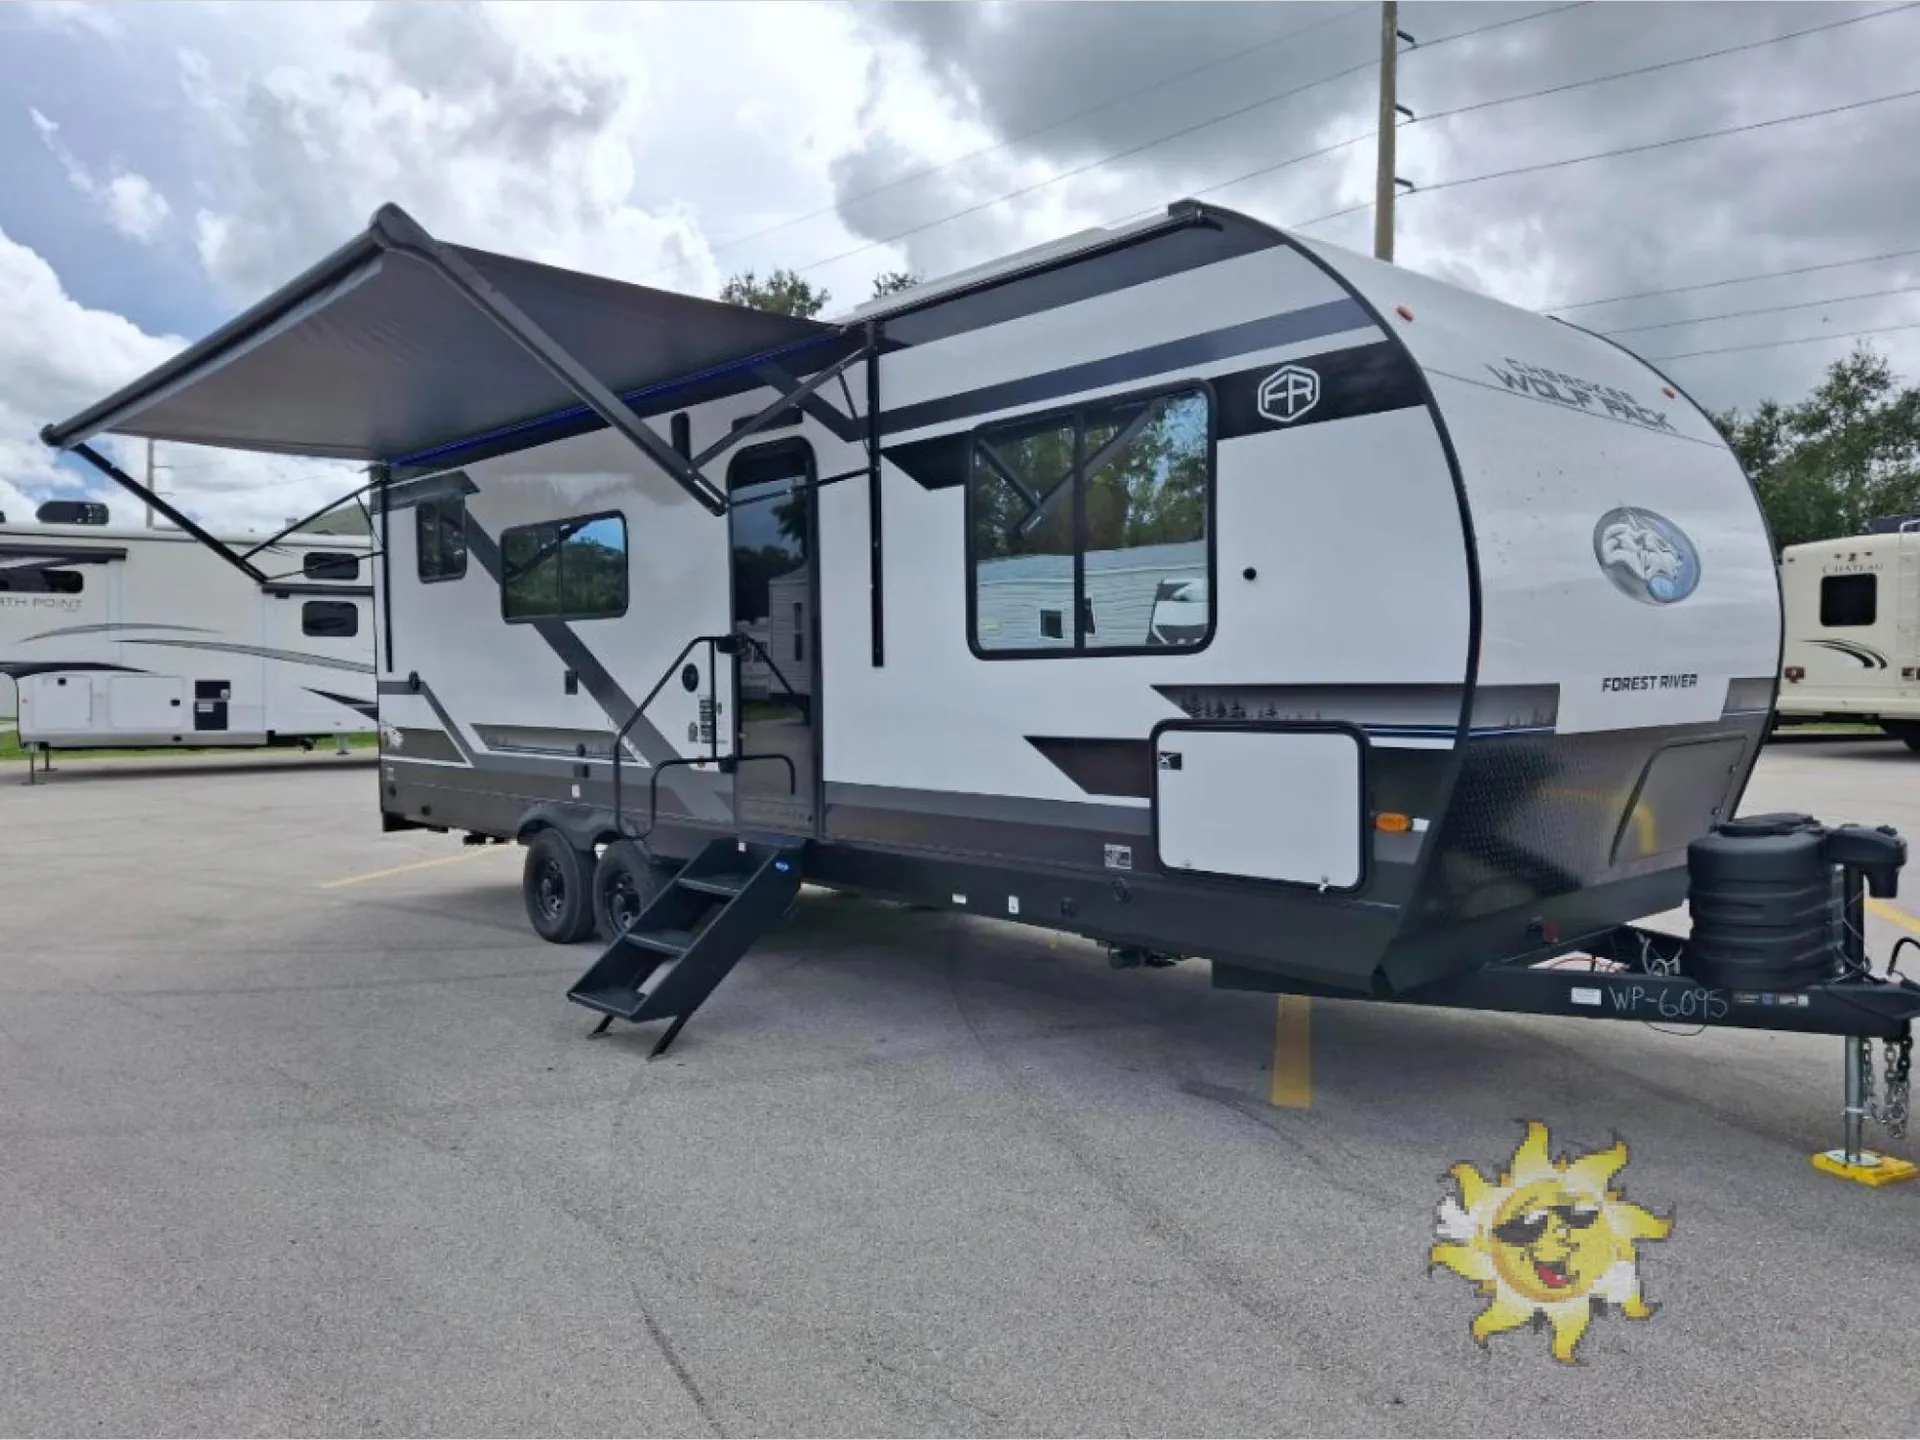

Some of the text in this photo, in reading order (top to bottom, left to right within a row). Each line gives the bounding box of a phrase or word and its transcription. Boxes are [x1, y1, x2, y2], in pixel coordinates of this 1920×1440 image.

[1484, 363, 1677, 432] WOLF PACK
[1602, 673, 1698, 691] FOREST RIVER
[1608, 984, 1729, 1019] WP-6095
